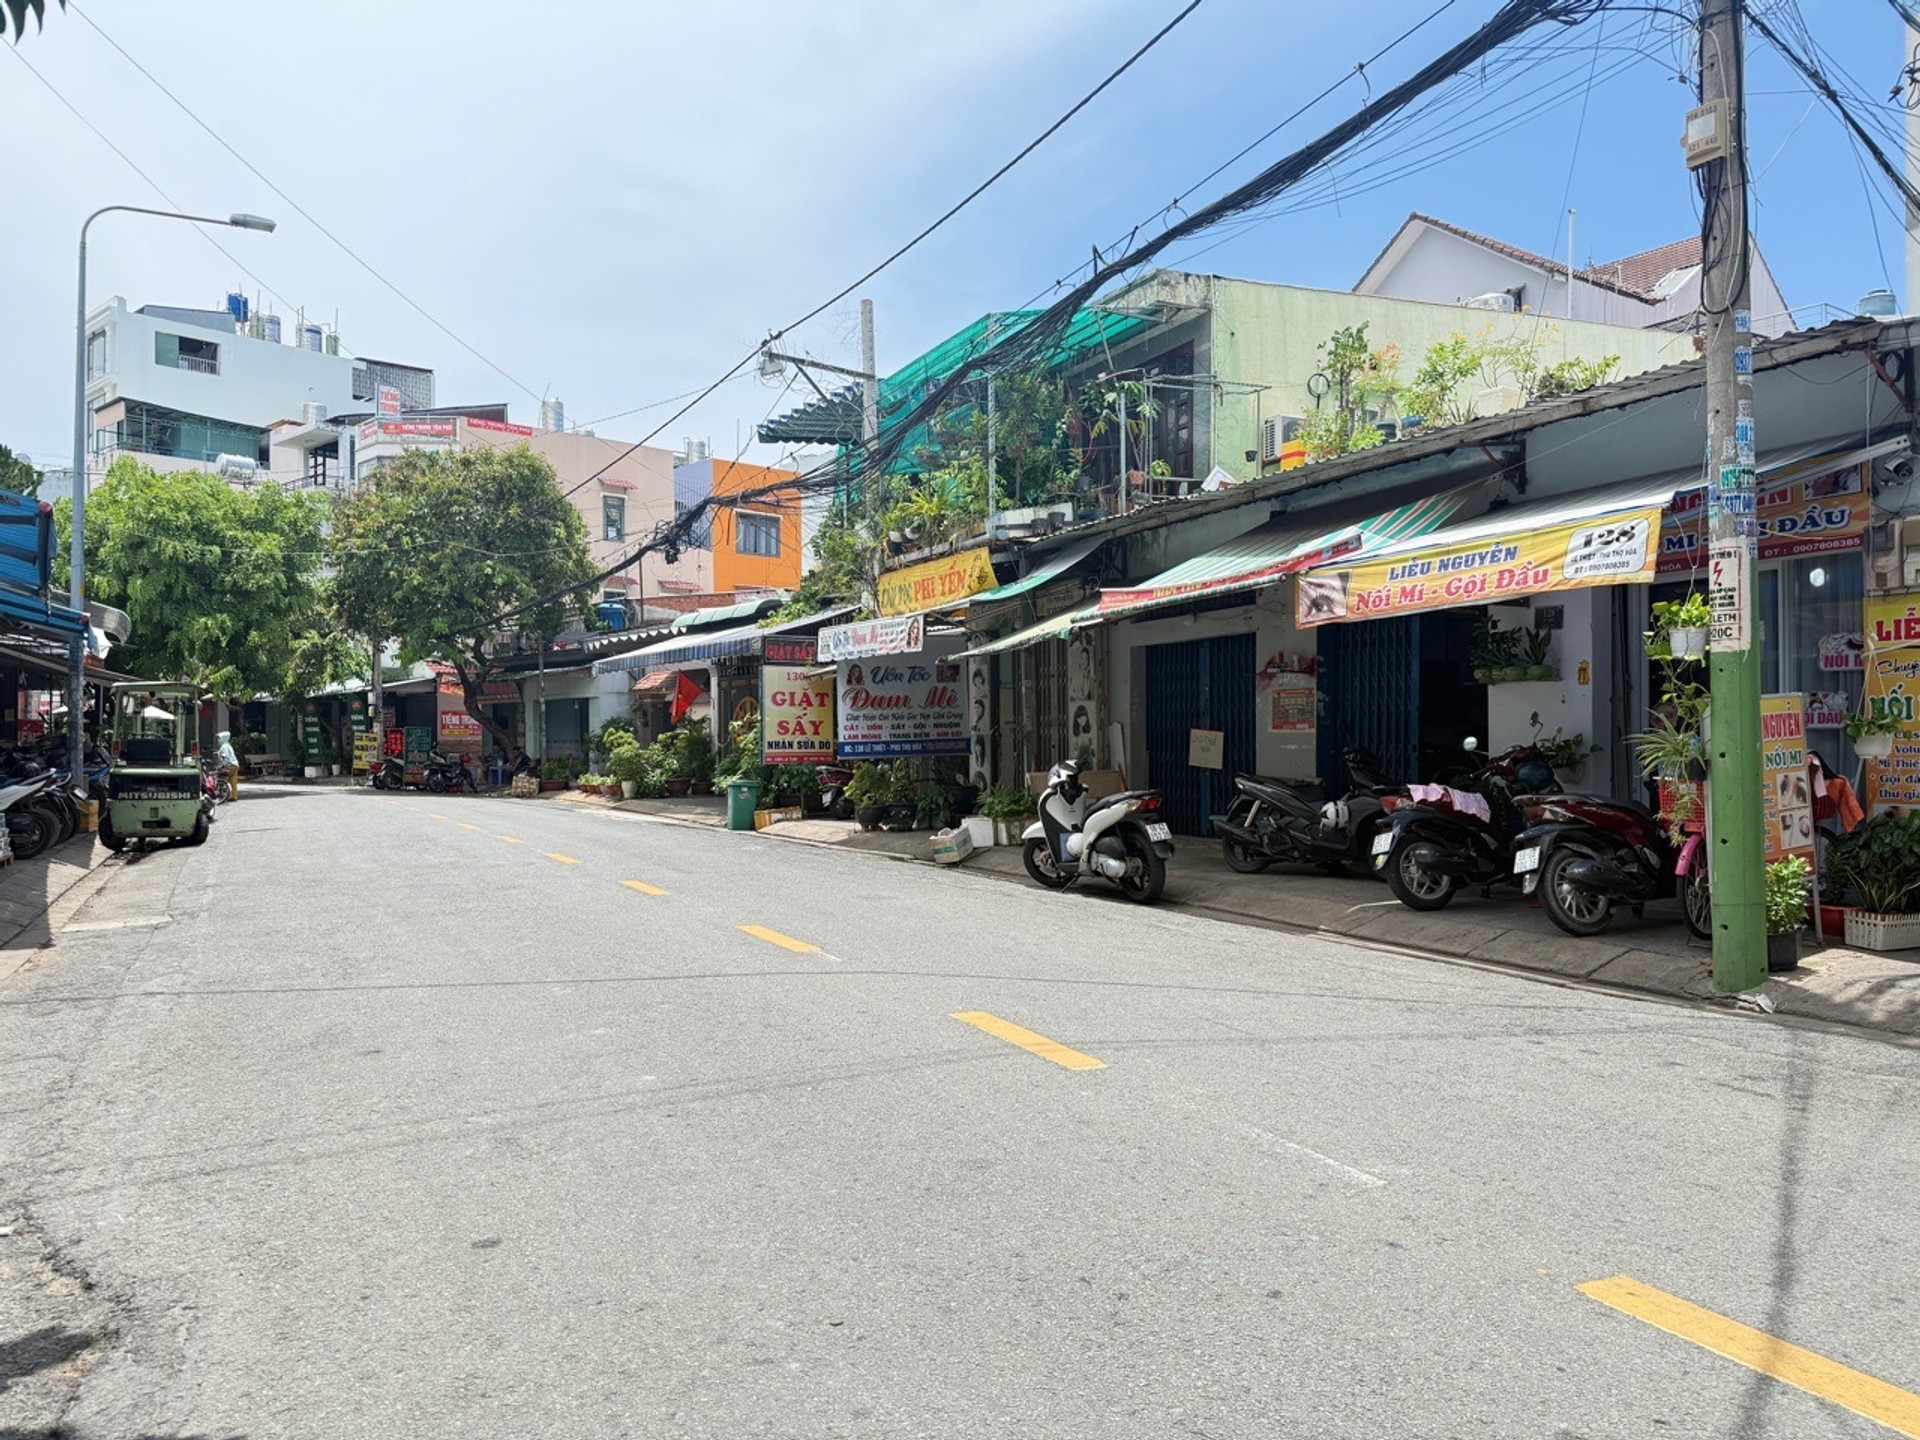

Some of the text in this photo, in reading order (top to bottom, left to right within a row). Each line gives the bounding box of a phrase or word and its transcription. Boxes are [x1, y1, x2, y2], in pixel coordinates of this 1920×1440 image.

[1583, 525, 1636, 548] 128
[1665, 532, 1697, 552] MI
[1777, 505, 1847, 533] ĐẦU
[1660, 562, 1682, 572] HÒA
[1793, 538, 1861, 554] 0907808385
[913, 576, 936, 602] PHI
[938, 559, 967, 597] YẾN
[1355, 584, 1392, 612] Nối
[1445, 573, 1488, 601] Gội
[1494, 560, 1550, 591] Đầu
[1709, 613, 1737, 624] LETH
[1709, 627, 1733, 639] 20C
[770, 687, 830, 711] GIẶT
[776, 712, 825, 736] SẤY
[1765, 744, 1803, 768] NỐI MI
[118, 791, 191, 800] MITSUBISHI
